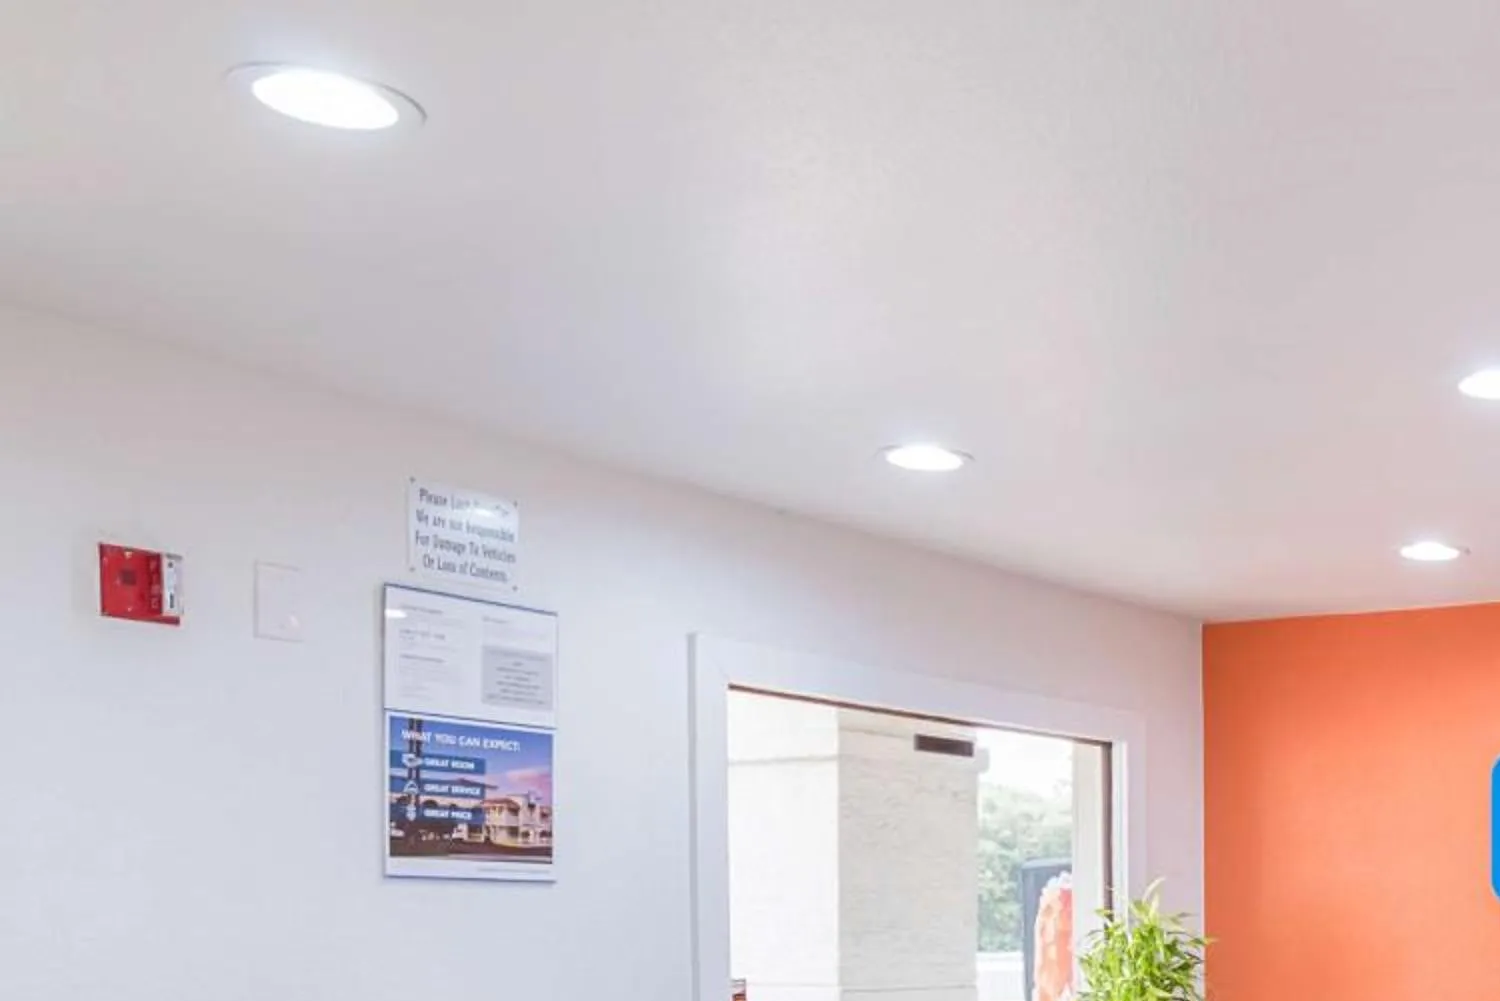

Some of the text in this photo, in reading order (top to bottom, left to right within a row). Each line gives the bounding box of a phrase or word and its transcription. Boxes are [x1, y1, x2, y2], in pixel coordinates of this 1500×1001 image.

[419, 487, 447, 507] Please
[415, 529, 430, 547] For
[433, 533, 466, 556] Damage
[481, 543, 516, 564] Vehicles
[437, 556, 457, 573] Loss
[401, 729, 432, 743] WHAT
[434, 732, 457, 746] YOU
[458, 735, 481, 748] CAN
[424, 756, 449, 768] GREAT
[423, 782, 482, 796] GREAT SERVICE
[423, 808, 449, 819] GREAT
